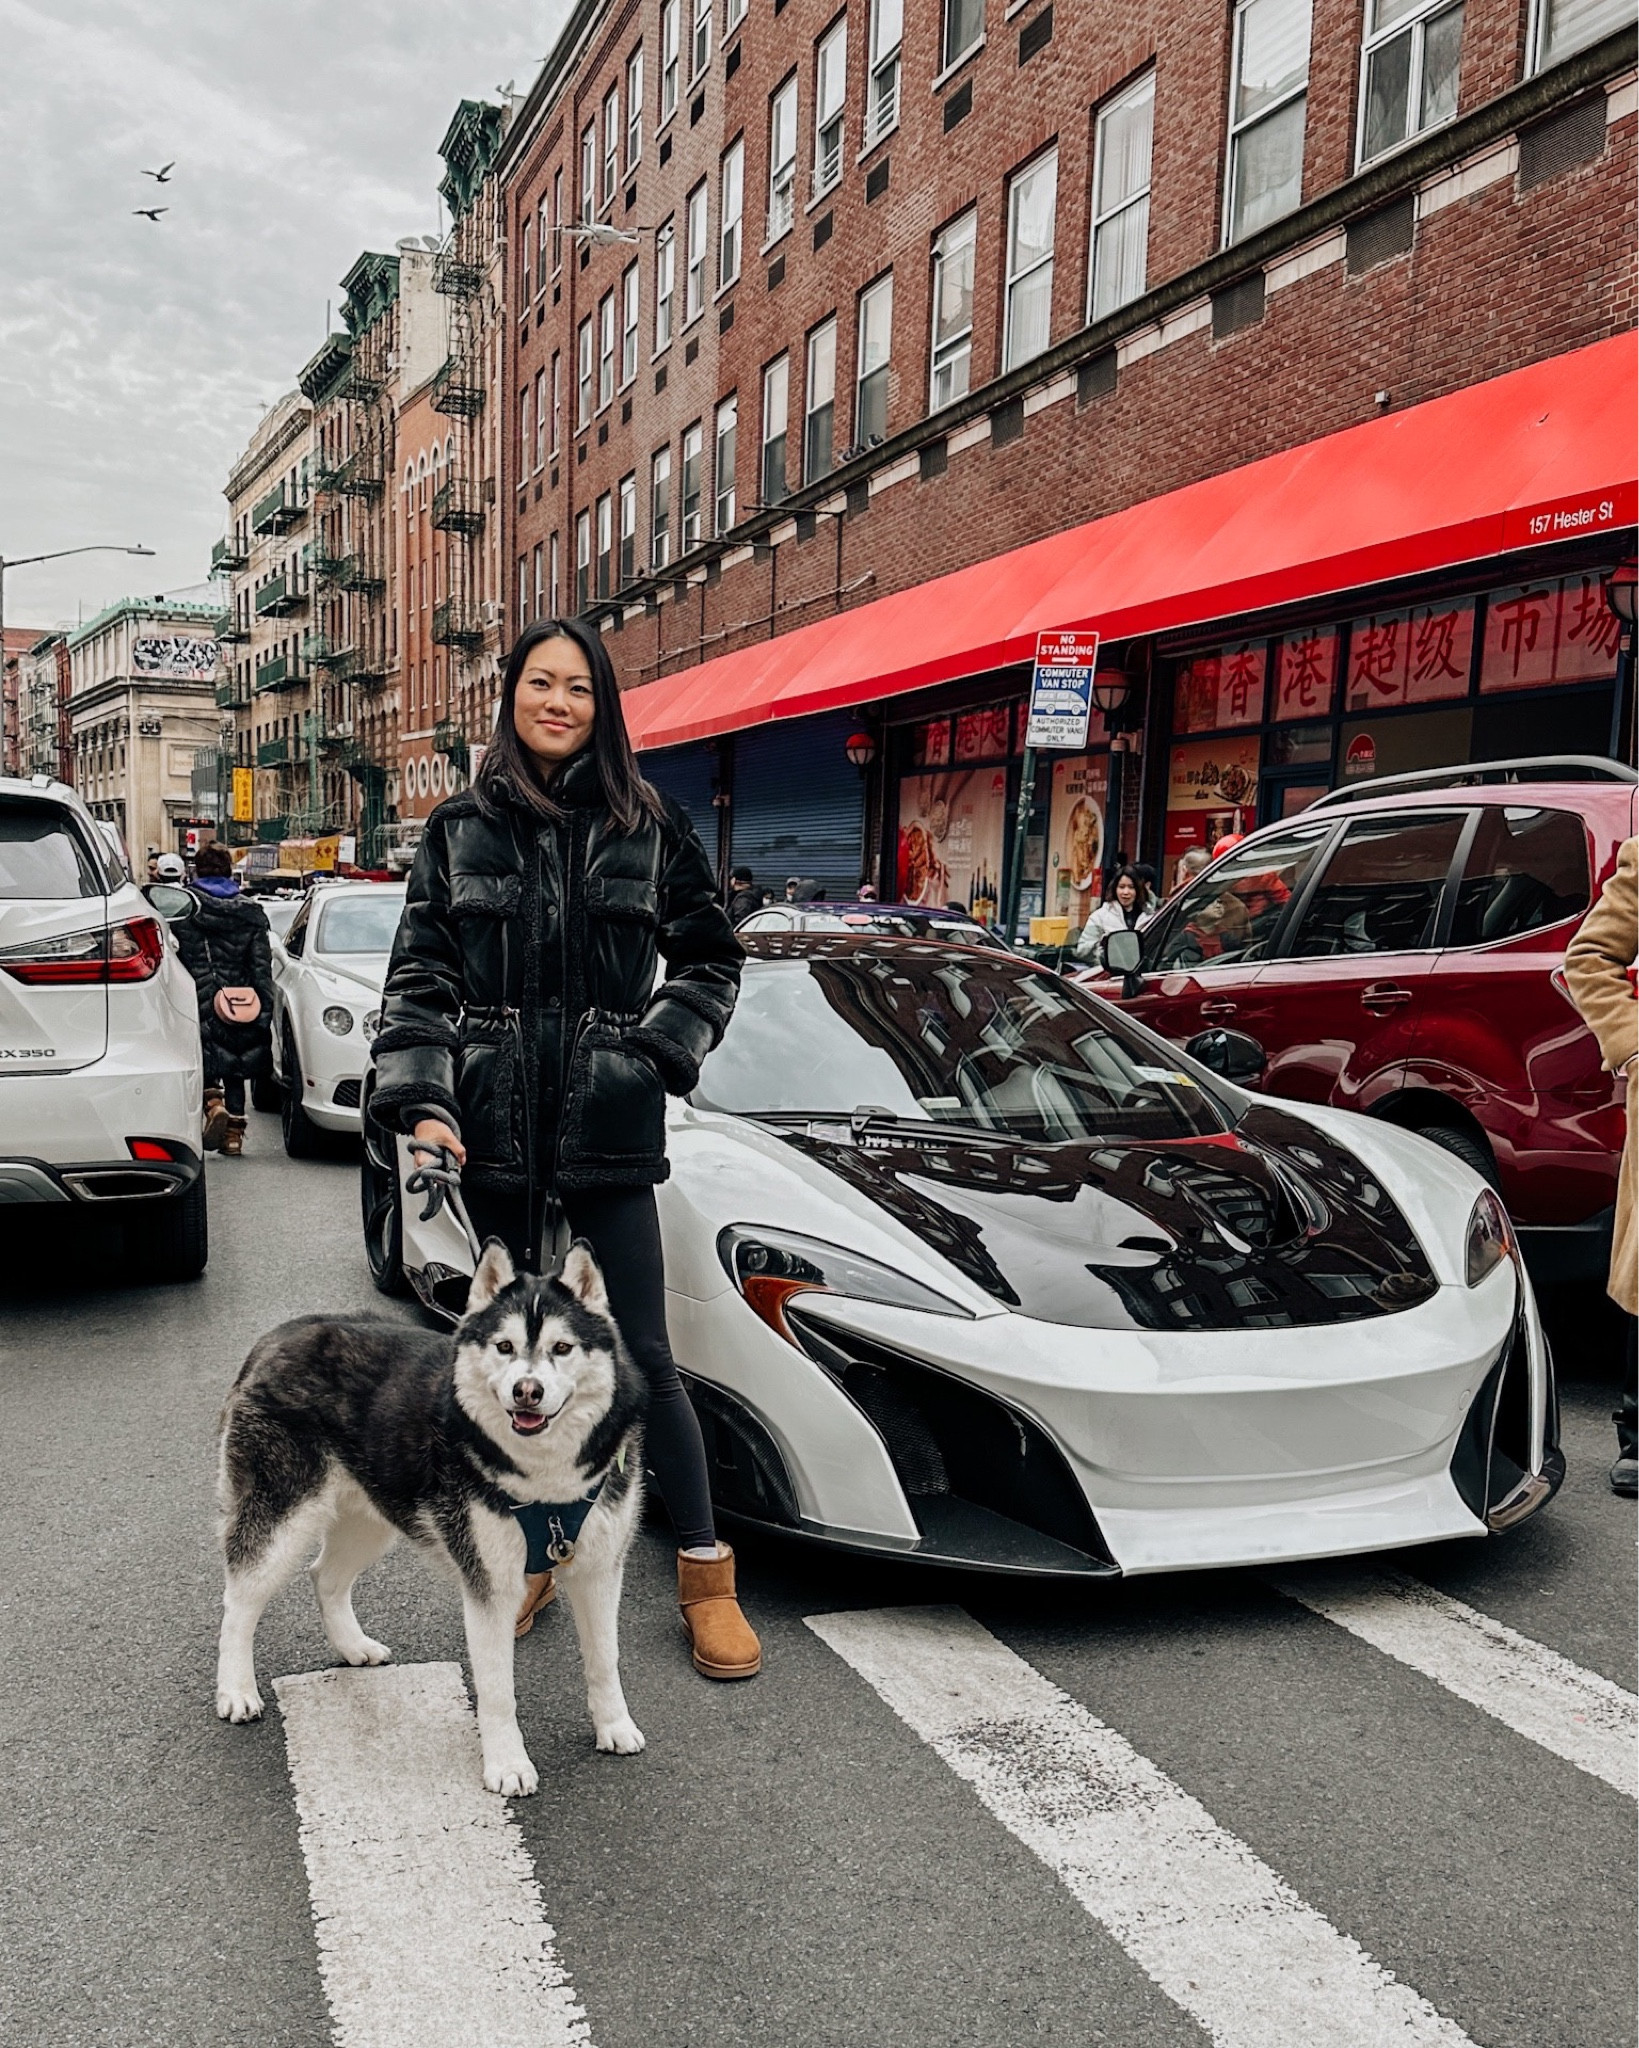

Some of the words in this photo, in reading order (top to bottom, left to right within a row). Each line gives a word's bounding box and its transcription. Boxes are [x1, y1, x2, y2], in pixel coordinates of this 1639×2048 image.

[1529, 513, 1551, 535] 157
[1553, 508, 1596, 530] Hester
[1598, 501, 1613, 520] St
[1060, 635, 1076, 645] NO
[1040, 645, 1094, 656] STANDING
[1039, 668, 1089, 678] COMMUTER
[1041, 678, 1060, 688] VAN
[1061, 679, 1085, 689] STOP
[1036, 717, 1081, 725] AUTHORIZED
[1030, 725, 1065, 734] COMMUTER
[1066, 727, 1084, 735] VANS
[1046, 734, 1066, 742] ONLY
[0, 1049, 17, 1058] X
[19, 1048, 56, 1058] 350
